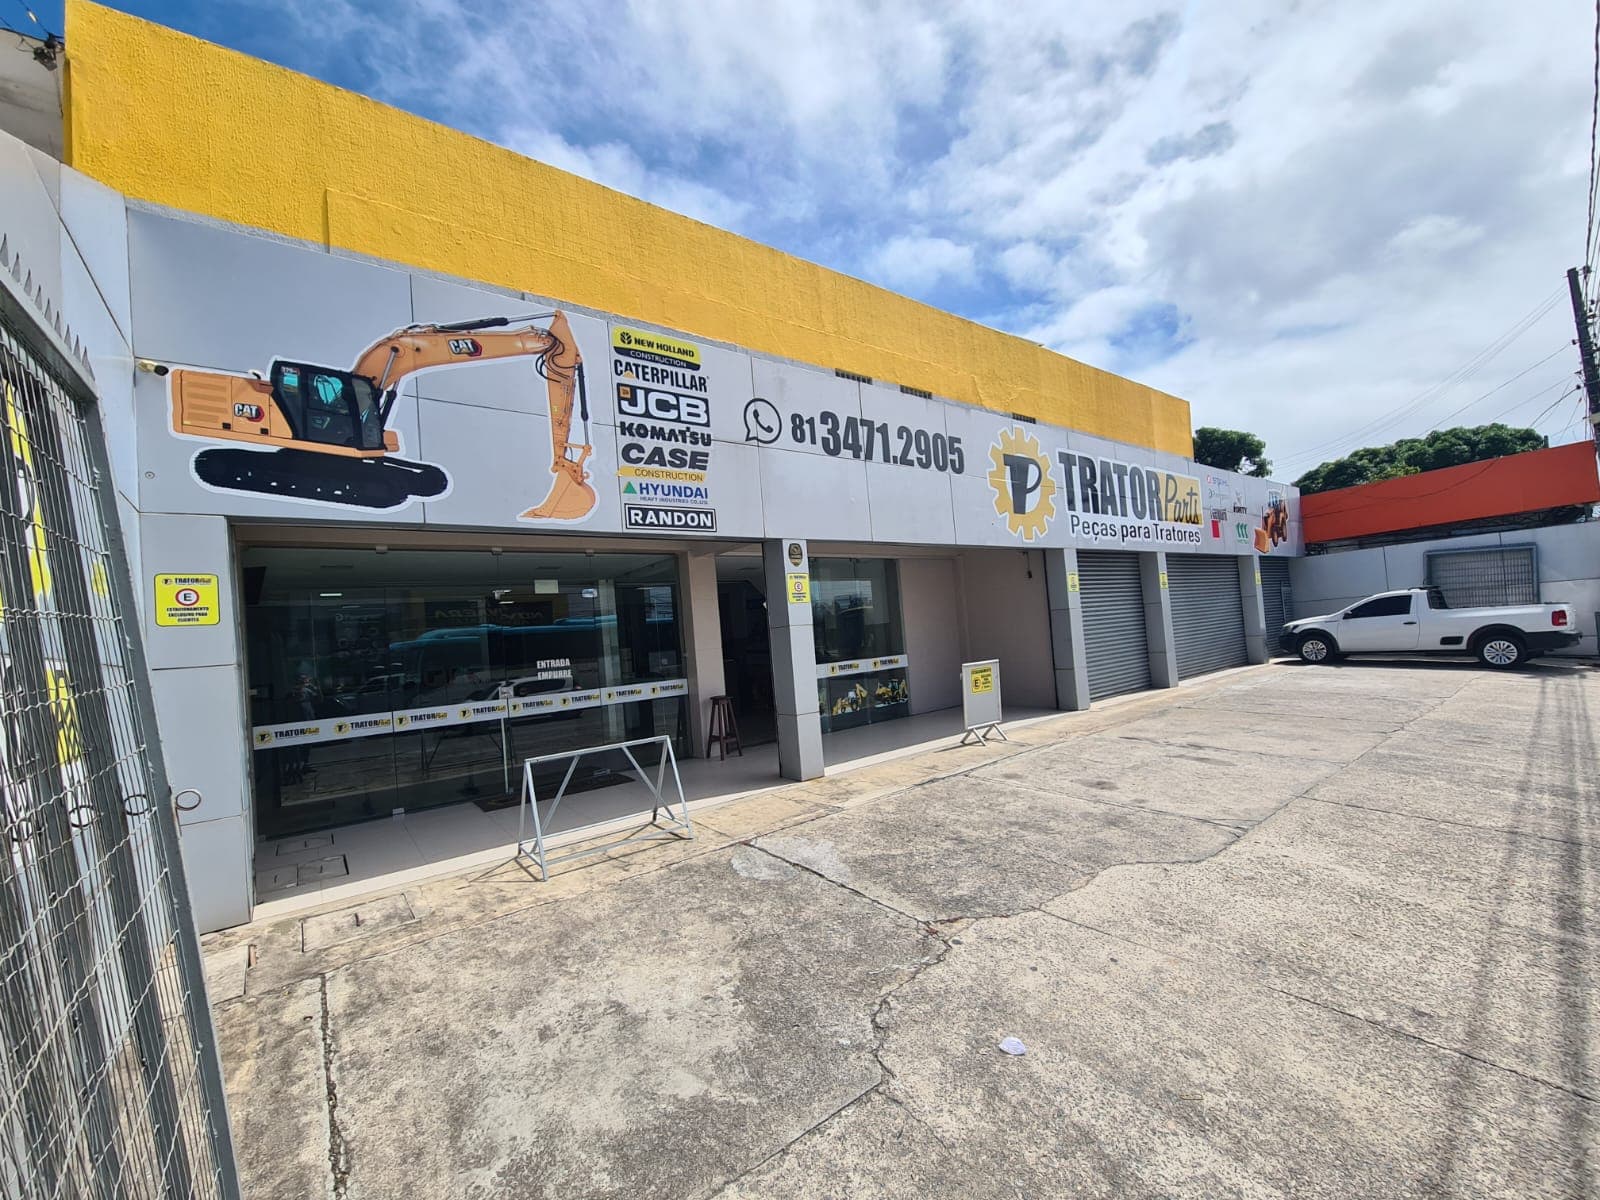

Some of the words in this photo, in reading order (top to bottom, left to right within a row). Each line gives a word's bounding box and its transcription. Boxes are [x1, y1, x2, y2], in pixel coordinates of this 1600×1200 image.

[449, 339, 475, 353] CAT
[634, 337, 655, 350] NEW
[656, 342, 695, 358] HOLLAND
[630, 350, 687, 367] CONSTRUCTION
[614, 358, 708, 393] CATERPILLAR
[234, 403, 258, 418] CAT
[620, 387, 709, 424] JCB
[619, 421, 712, 447] KOMATSU
[790, 412, 817, 445] 81
[819, 410, 965, 475] 3471.2905
[621, 443, 710, 471] CASE
[634, 468, 704, 482] CONSTRUCTION
[639, 482, 709, 499] HYUNDAI
[1057, 451, 1164, 522] TRATOR
[630, 508, 713, 528] RANDON
[1070, 514, 1117, 541] Peças
[1121, 524, 1151, 543] para
[1153, 523, 1201, 543] Tratores
[183, 592, 193, 602] E
[536, 658, 571, 669] ENTRADA
